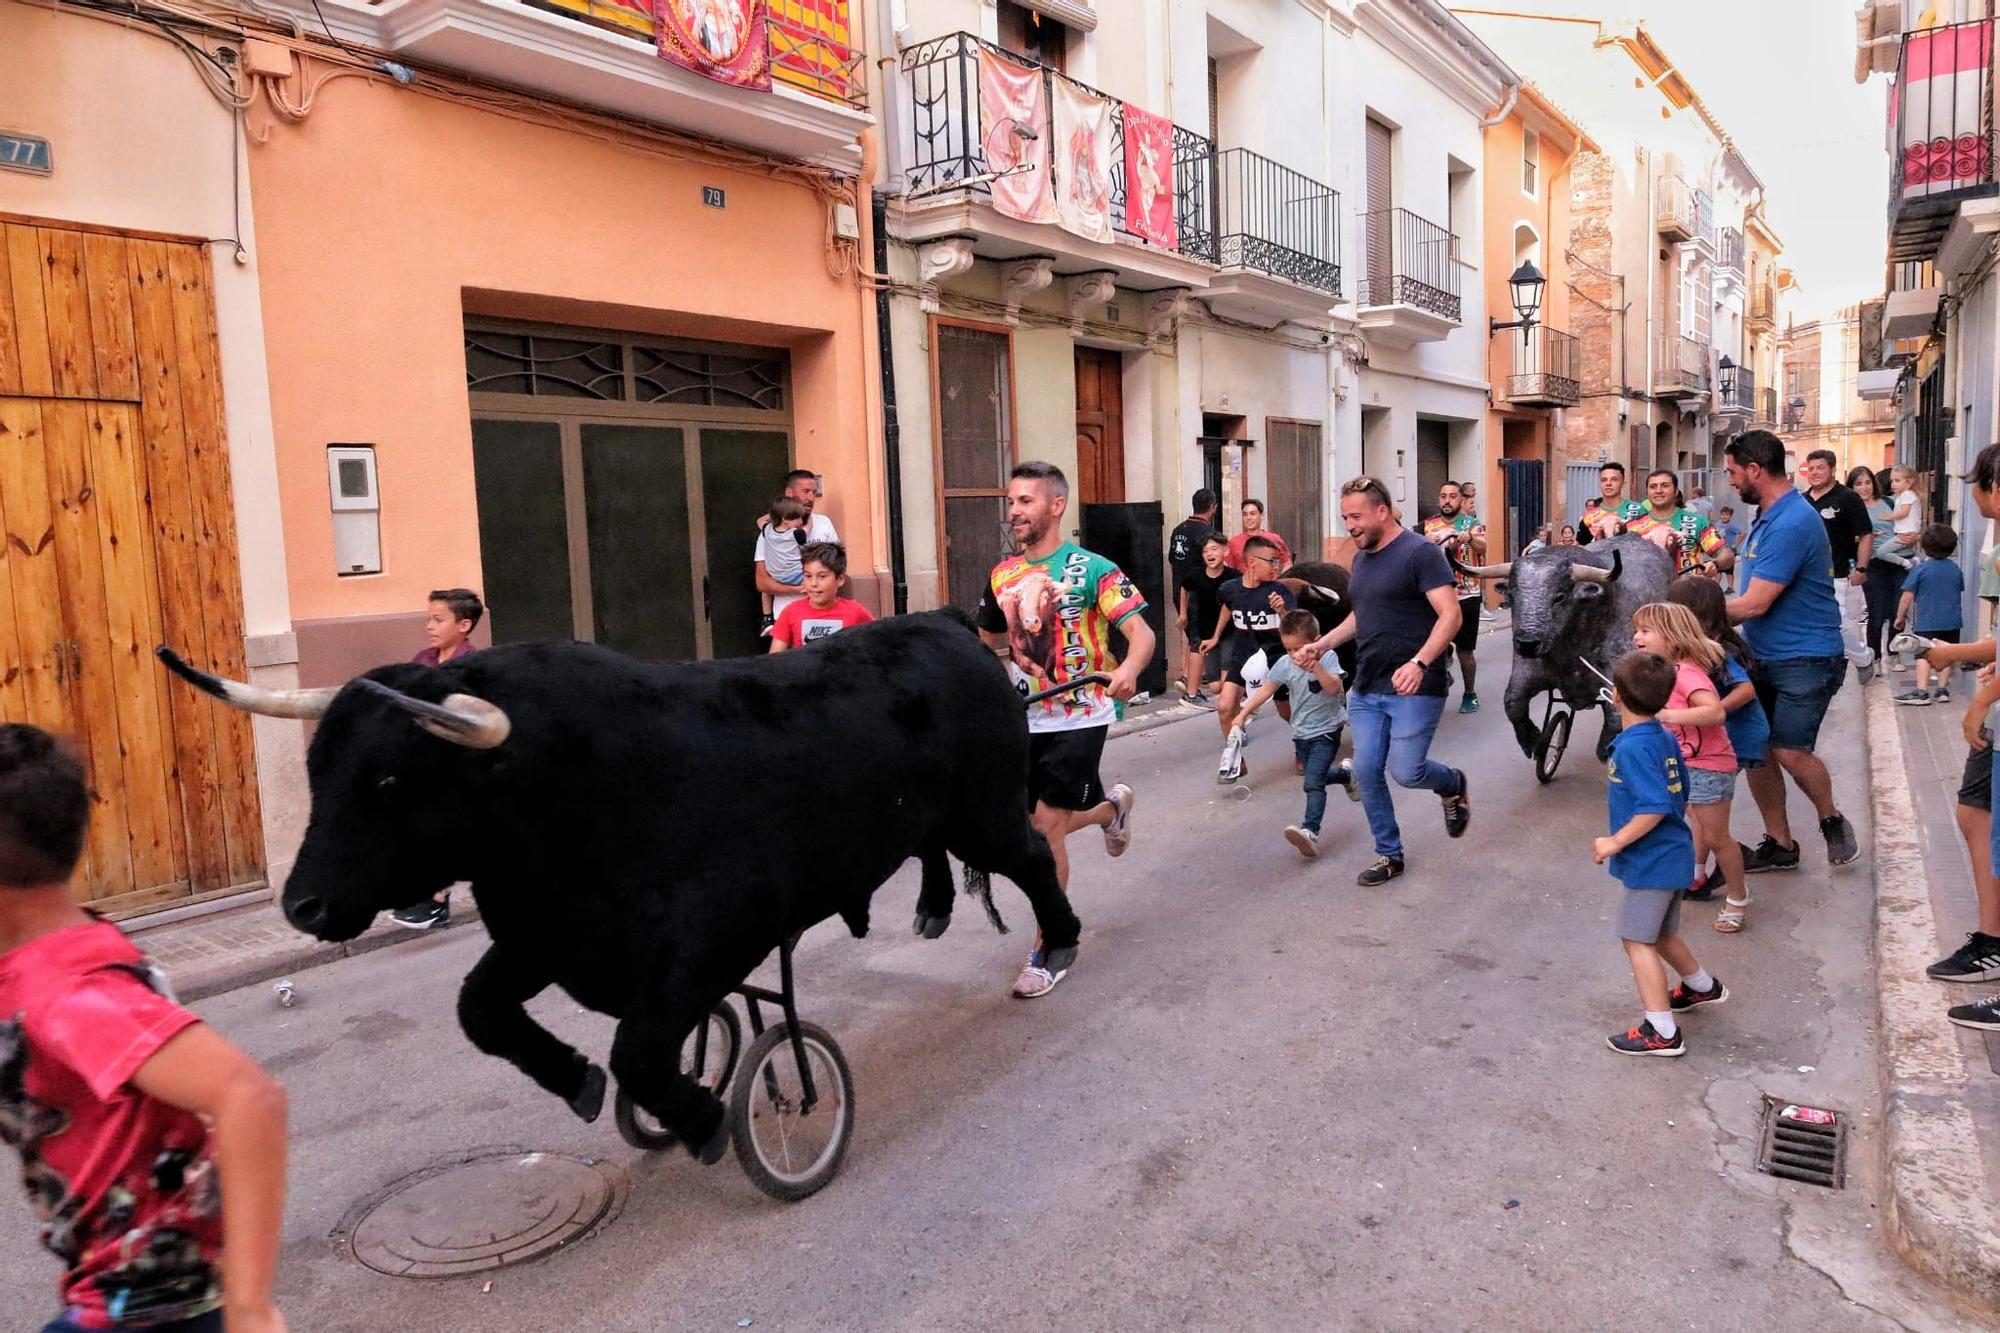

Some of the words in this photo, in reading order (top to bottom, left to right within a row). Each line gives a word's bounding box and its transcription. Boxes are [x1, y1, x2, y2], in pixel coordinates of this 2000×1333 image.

[8, 140, 35, 164] 77
[707, 189, 720, 206] 79
[809, 625, 832, 637] NIKE
